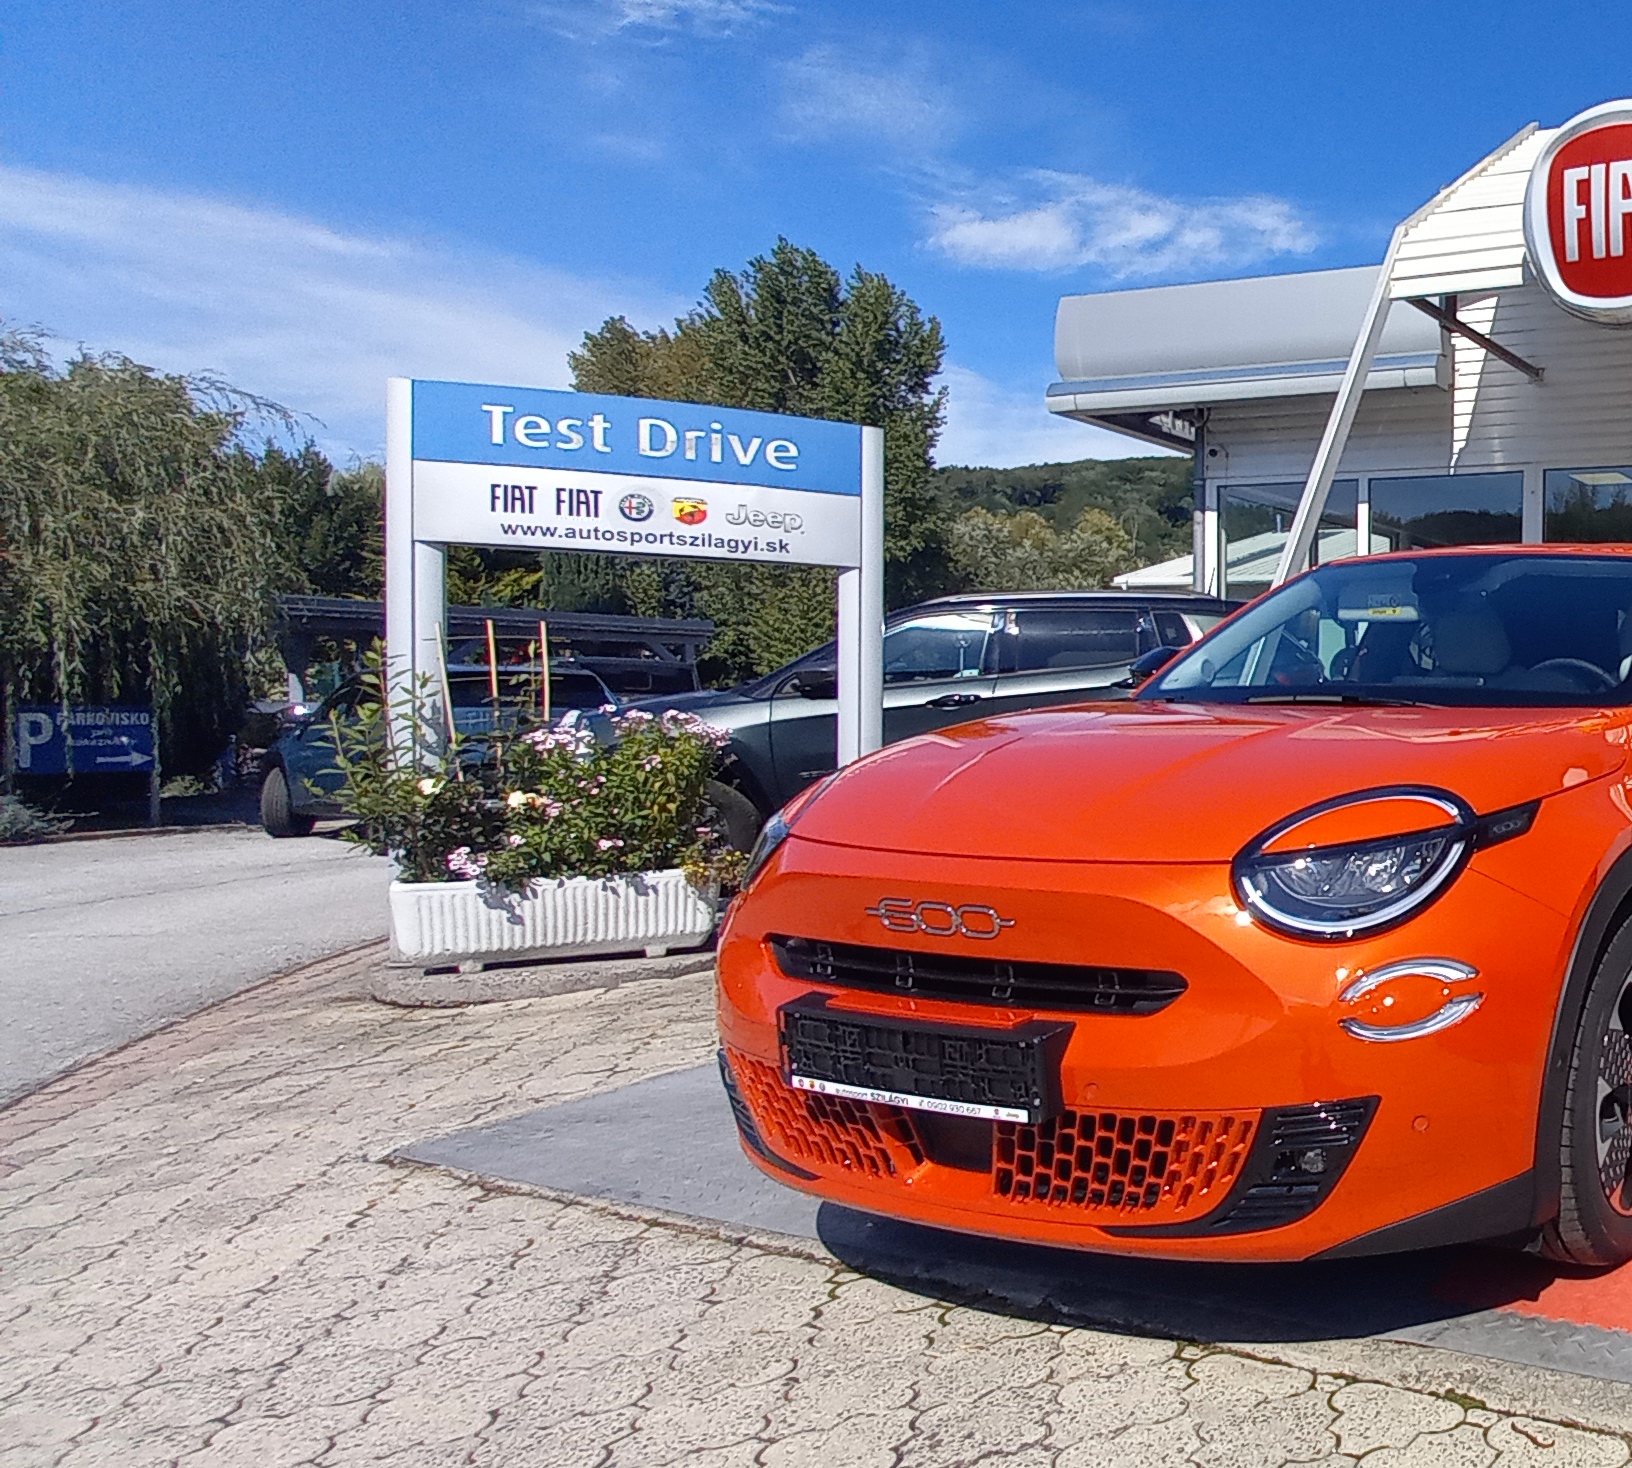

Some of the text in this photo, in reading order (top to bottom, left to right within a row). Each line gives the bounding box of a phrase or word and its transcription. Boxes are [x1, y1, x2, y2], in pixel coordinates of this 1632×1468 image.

[480, 403, 800, 471] Test Drive
[490, 483, 538, 514] FIAT
[556, 487, 603, 518] FIAT
[725, 504, 803, 534] Jeep
[500, 523, 791, 554] www.autosportszilagyi.sk
[18, 711, 150, 769] P PARKOVISKO
[865, 897, 1015, 940] 600
